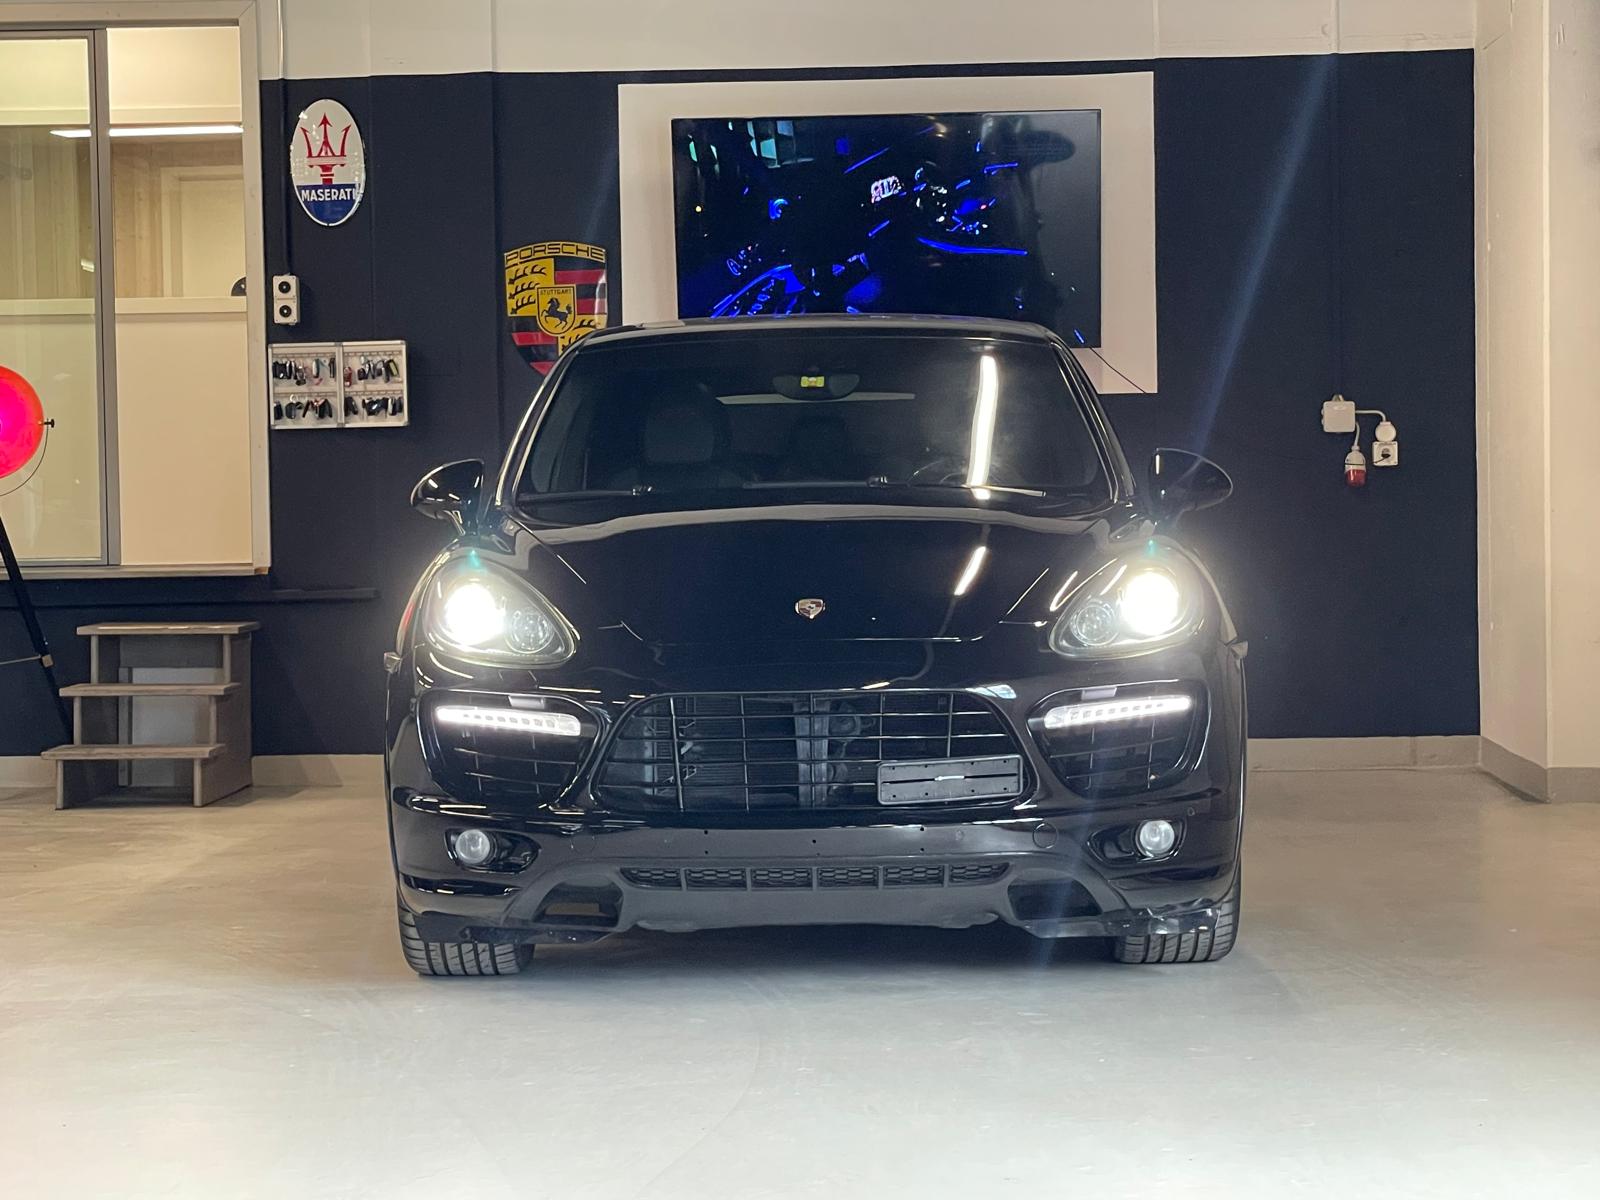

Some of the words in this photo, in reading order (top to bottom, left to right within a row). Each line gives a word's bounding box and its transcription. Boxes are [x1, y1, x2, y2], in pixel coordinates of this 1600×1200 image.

[301, 188, 356, 201] MASERATI
[505, 243, 605, 264] PORSCHE
[540, 288, 572, 296] STUTTGART
